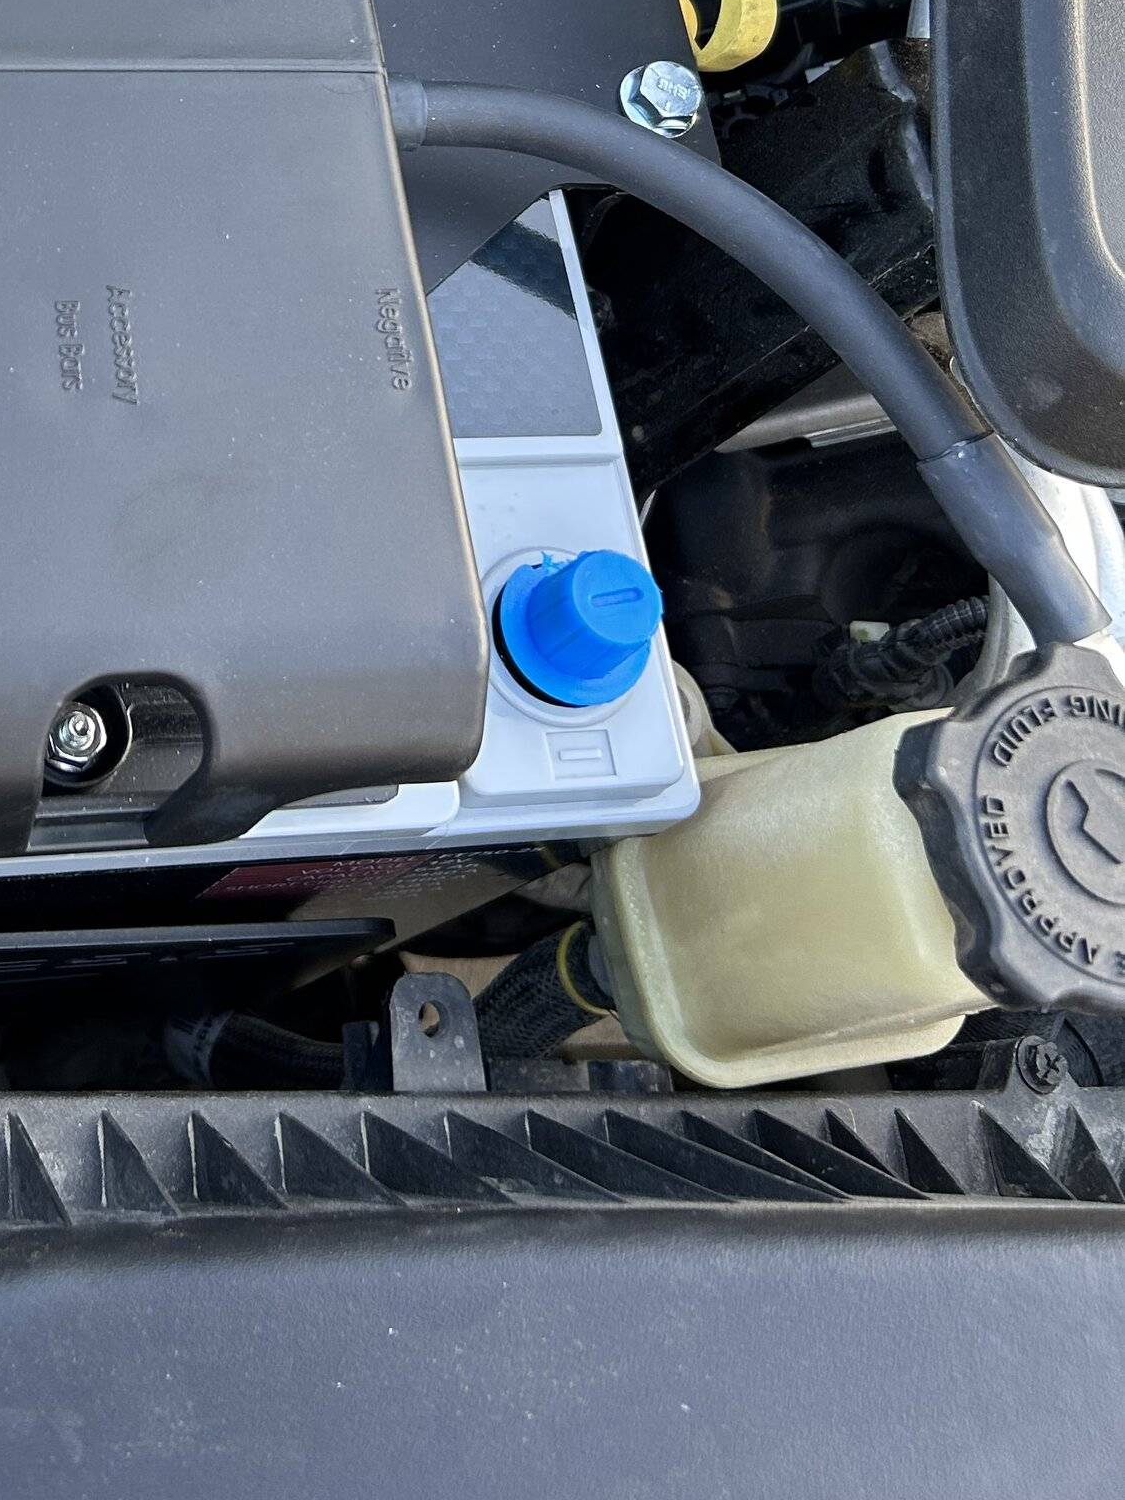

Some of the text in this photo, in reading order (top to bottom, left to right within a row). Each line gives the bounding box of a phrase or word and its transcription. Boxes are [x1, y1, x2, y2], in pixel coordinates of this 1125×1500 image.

[55, 299, 86, 391] Bus Bars
[106, 284, 140, 406] Accessory
[375, 287, 415, 391] Negative
[992, 696, 1057, 768] FLUID
[980, 791, 1100, 966] APPROVED
